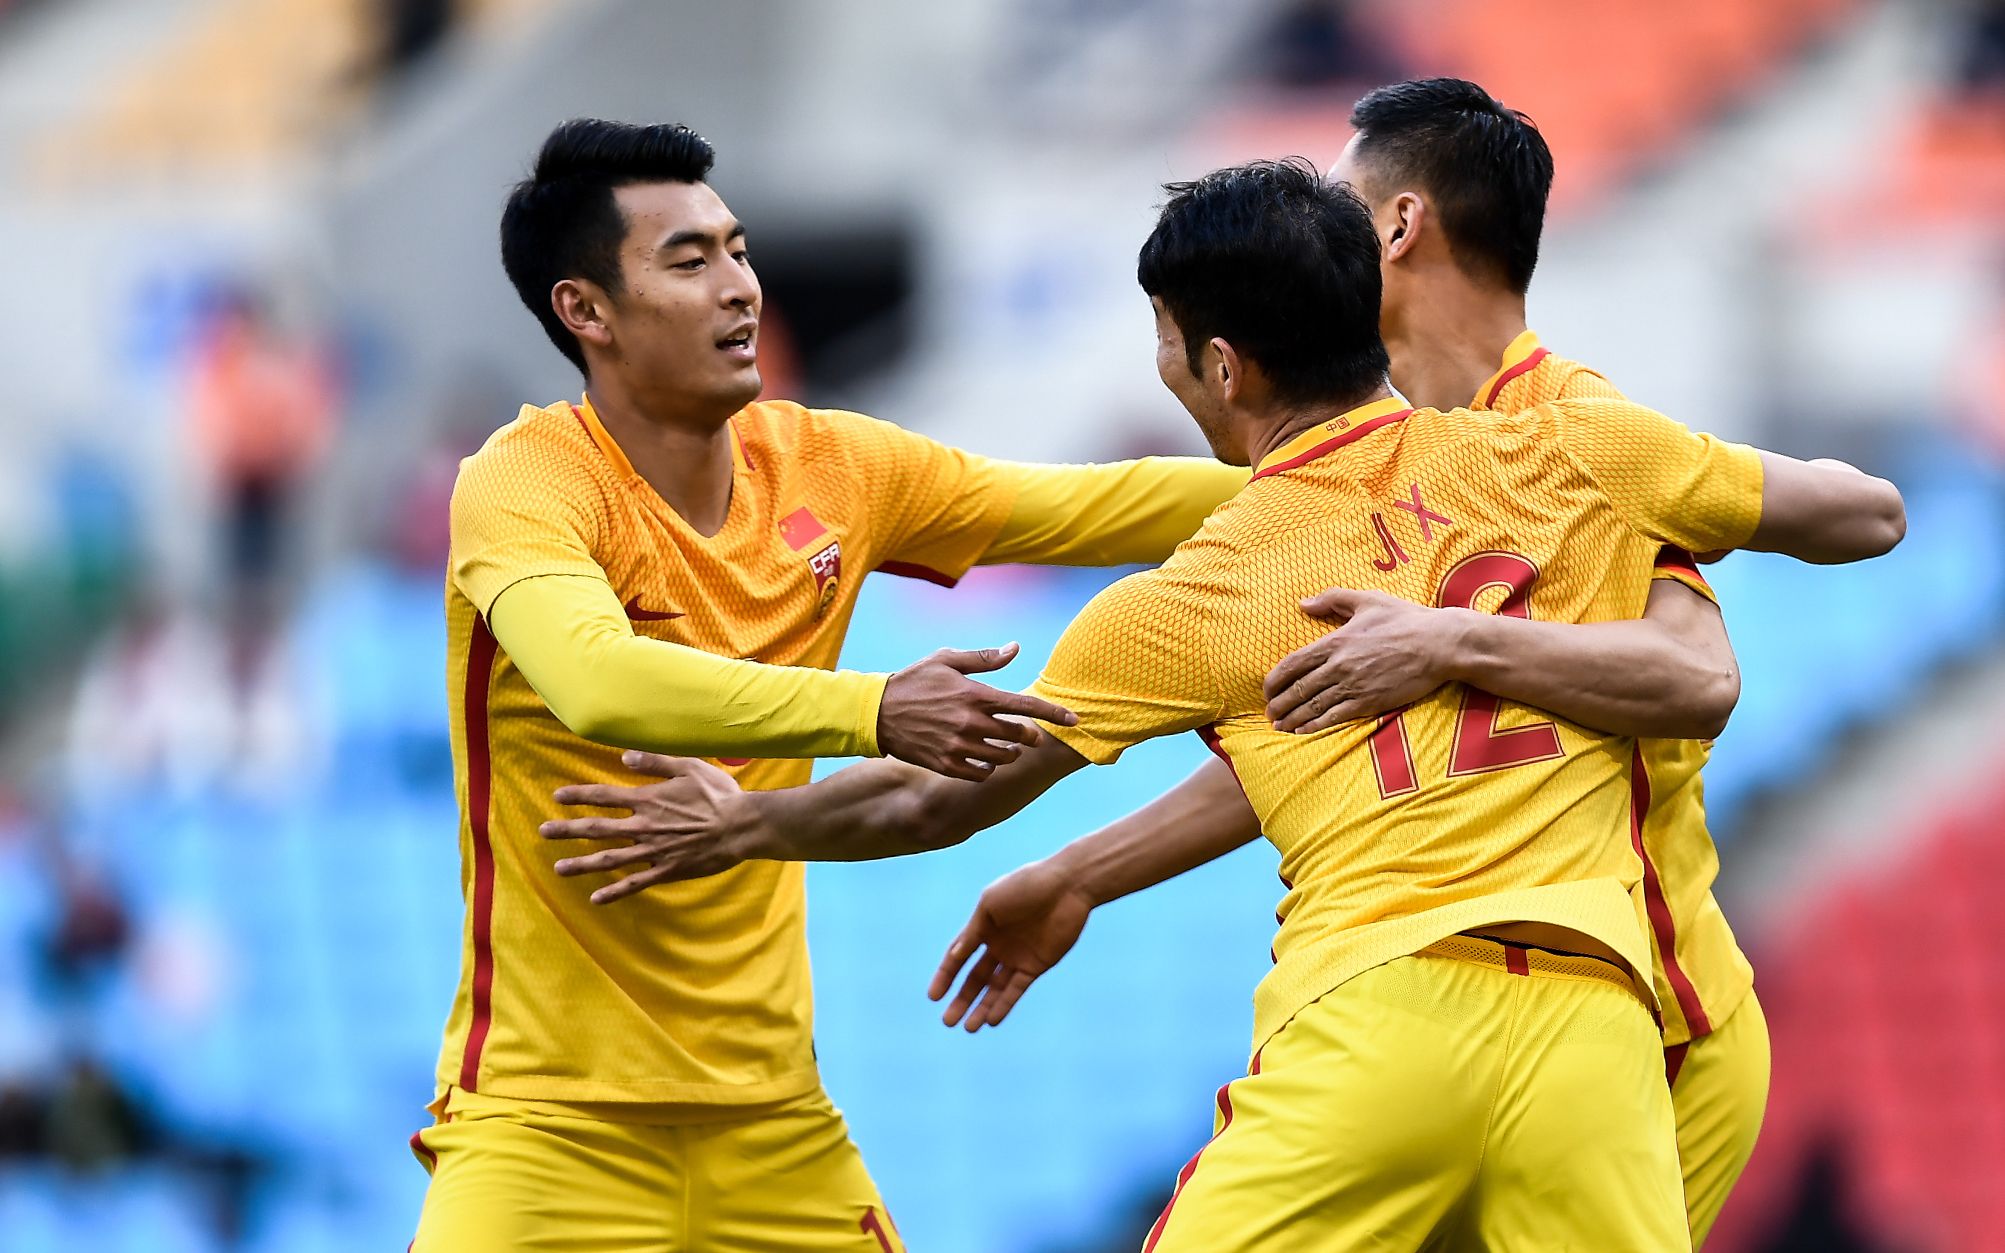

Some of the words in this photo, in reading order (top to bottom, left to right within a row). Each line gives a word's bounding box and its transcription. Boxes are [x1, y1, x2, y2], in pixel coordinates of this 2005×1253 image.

[1326, 416, 1350, 433] 中国
[1372, 512, 1410, 571] JI
[1394, 483, 1452, 542] X
